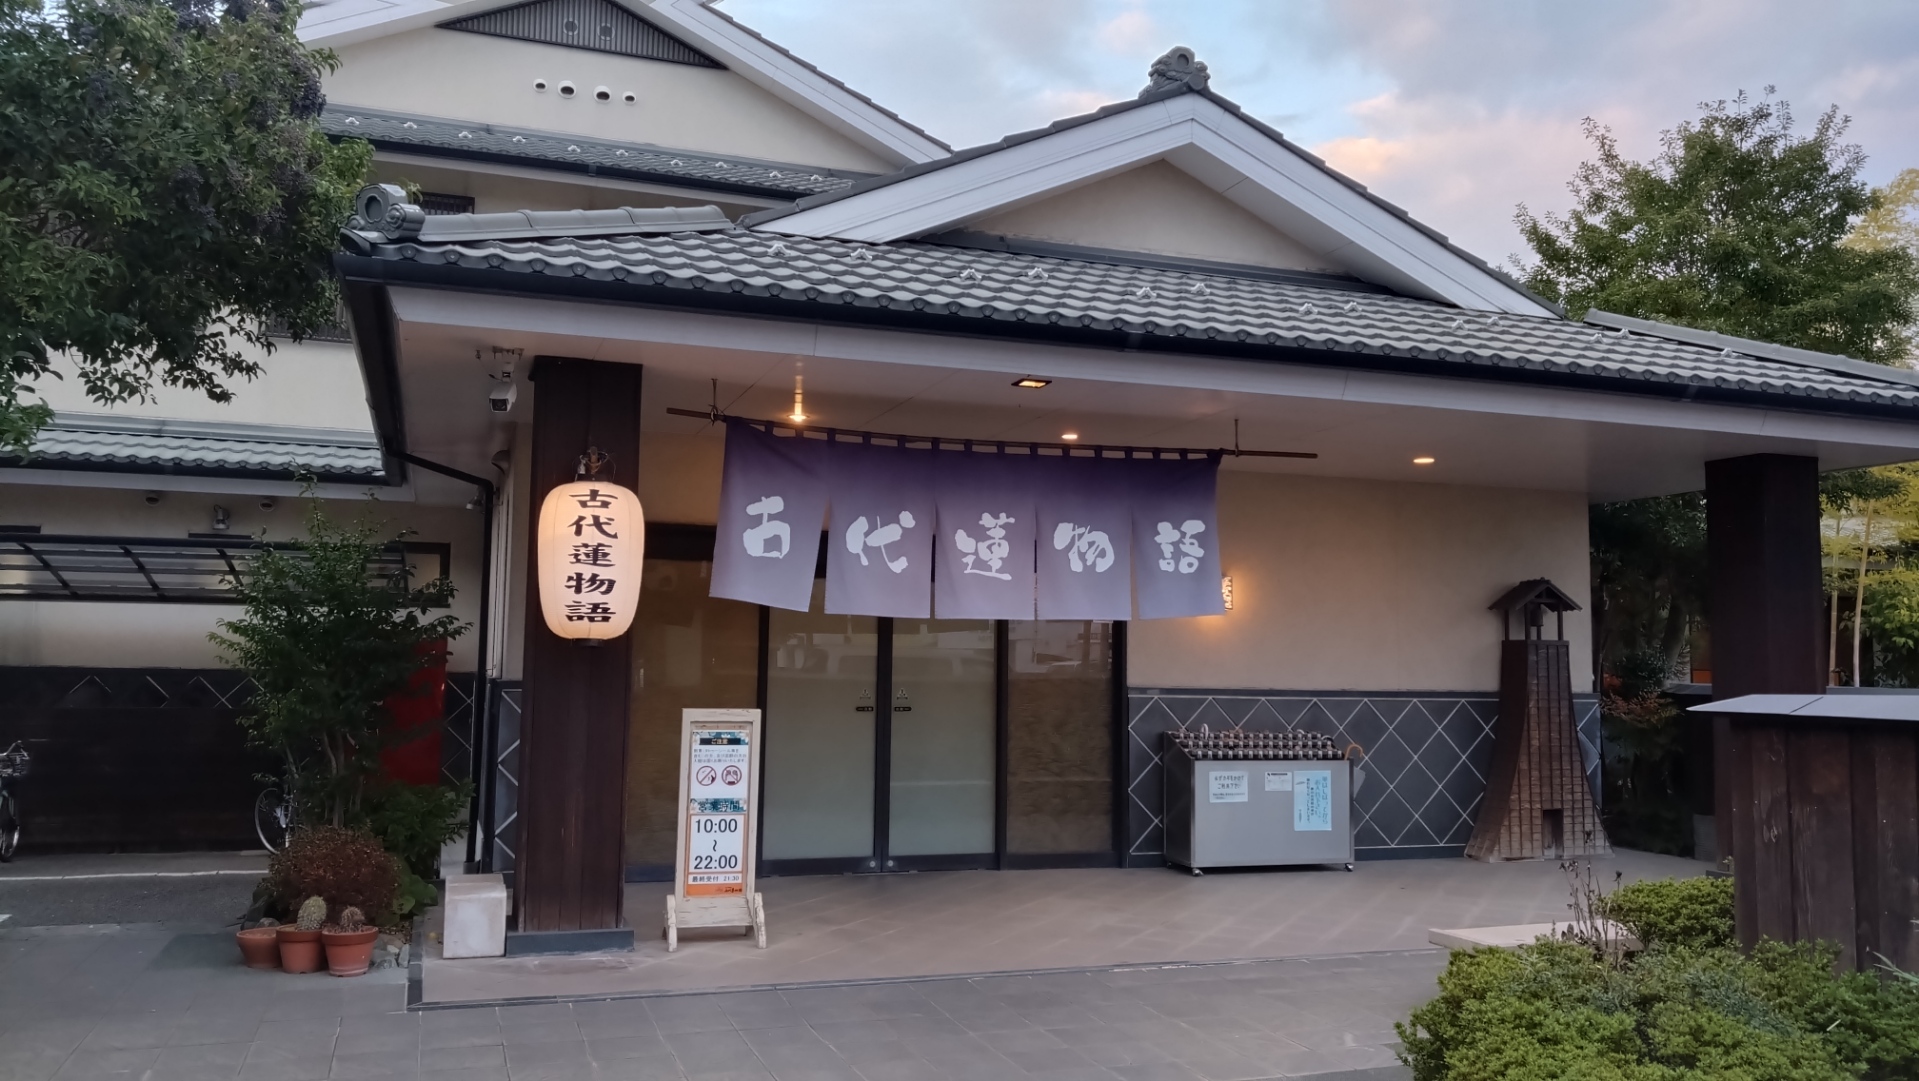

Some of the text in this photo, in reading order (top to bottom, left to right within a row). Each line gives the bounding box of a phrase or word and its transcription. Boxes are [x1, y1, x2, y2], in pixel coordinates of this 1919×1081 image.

[564, 488, 619, 623] 古代蓮物語
[695, 818, 738, 834] 10:00
[693, 854, 738, 870] 22:00
